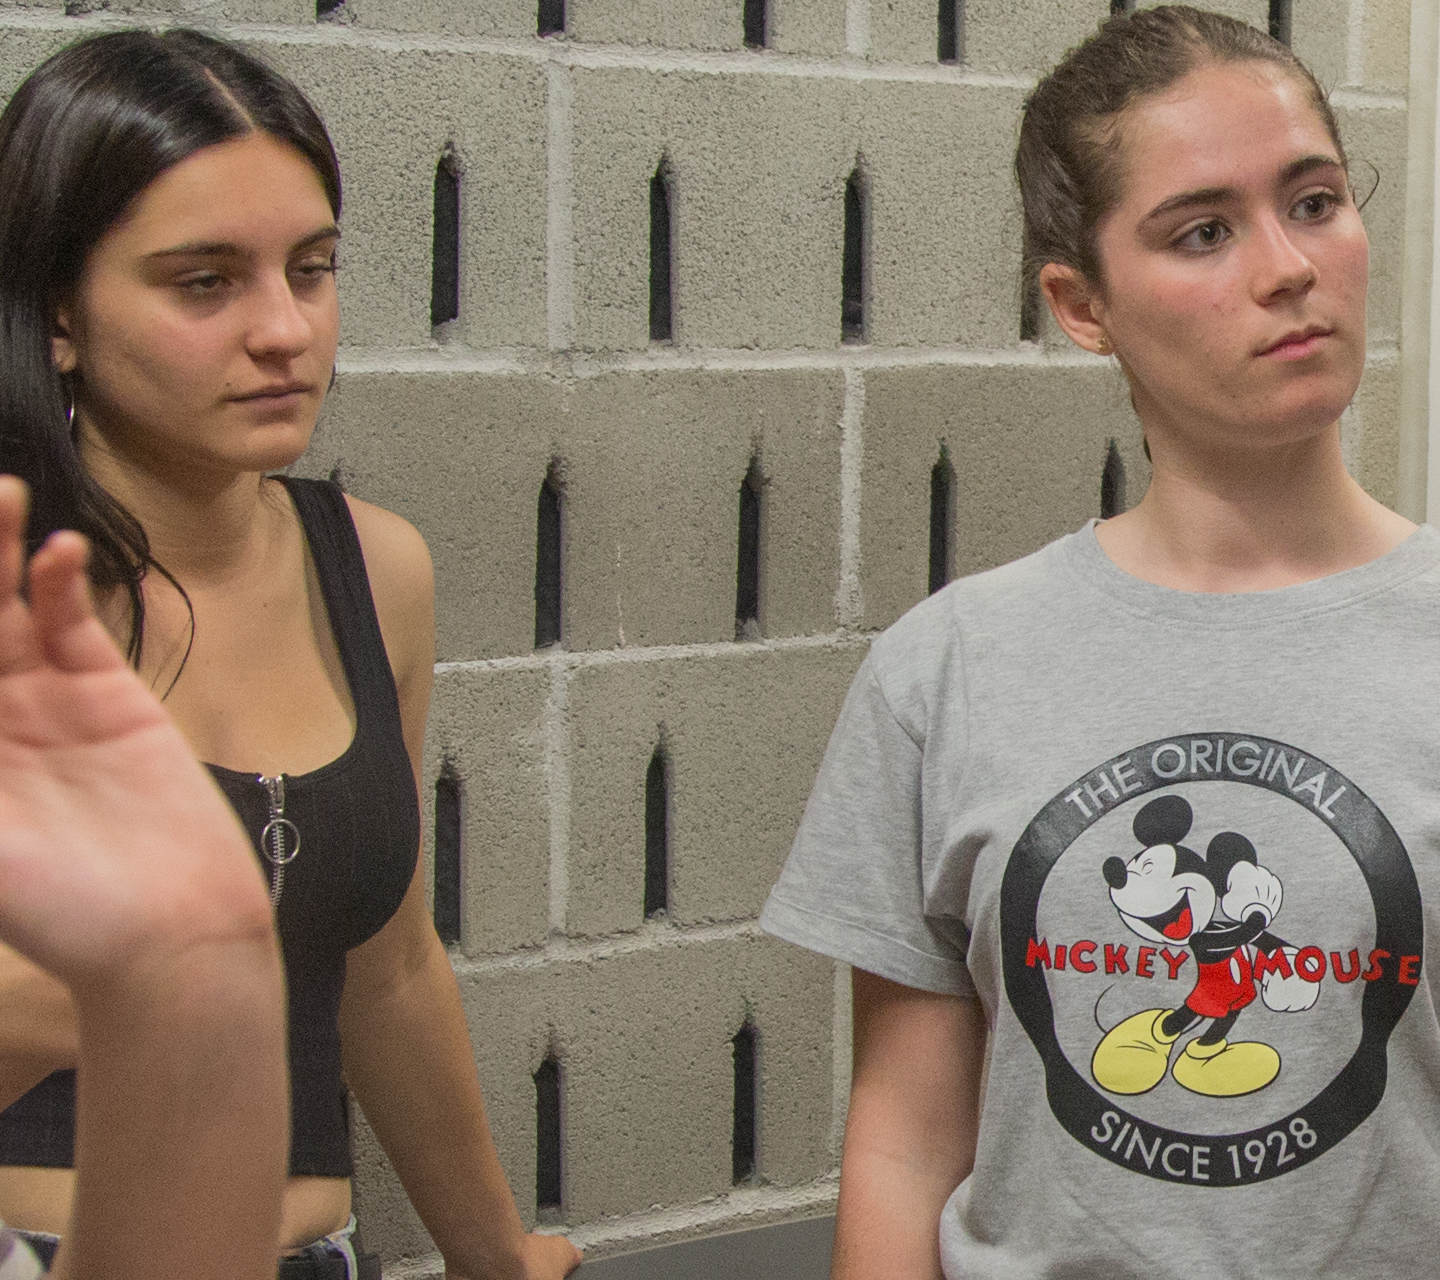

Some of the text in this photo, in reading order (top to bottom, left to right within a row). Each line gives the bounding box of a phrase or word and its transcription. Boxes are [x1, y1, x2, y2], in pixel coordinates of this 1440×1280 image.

[1064, 738, 1347, 820] THE ORIGINAL
[1025, 937, 1421, 987] MICKEY MOUSE
[1089, 1110, 1318, 1181] SINCE 1928
